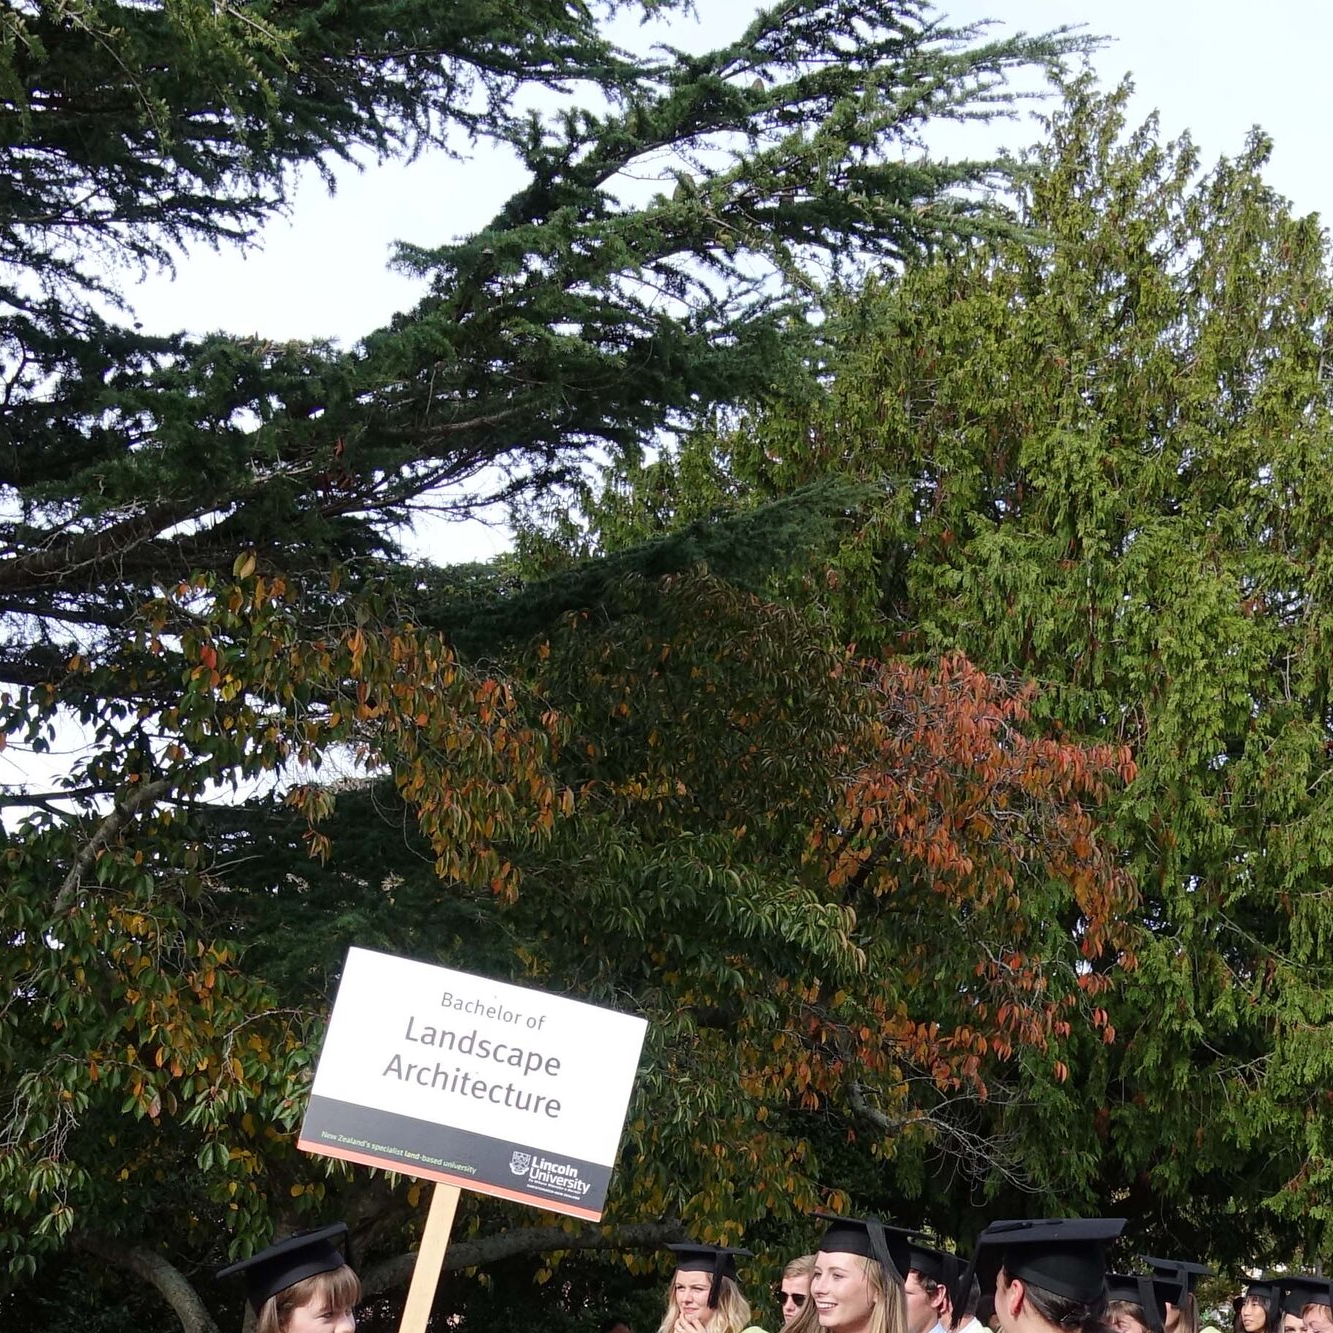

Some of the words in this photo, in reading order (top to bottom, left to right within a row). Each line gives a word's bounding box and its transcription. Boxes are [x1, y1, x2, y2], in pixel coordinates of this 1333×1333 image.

[441, 992, 522, 1024] Bachelor
[527, 1015, 547, 1031] of
[405, 1016, 561, 1076] Landscape
[382, 1053, 561, 1119] Architecture
[321, 1130, 337, 1140] New
[338, 1134, 371, 1148] Zealand's
[371, 1142, 404, 1156] specialist
[404, 1150, 443, 1166] land-based
[443, 1160, 478, 1175] university
[531, 1156, 578, 1177] Lincoln
[529, 1167, 591, 1195] University
